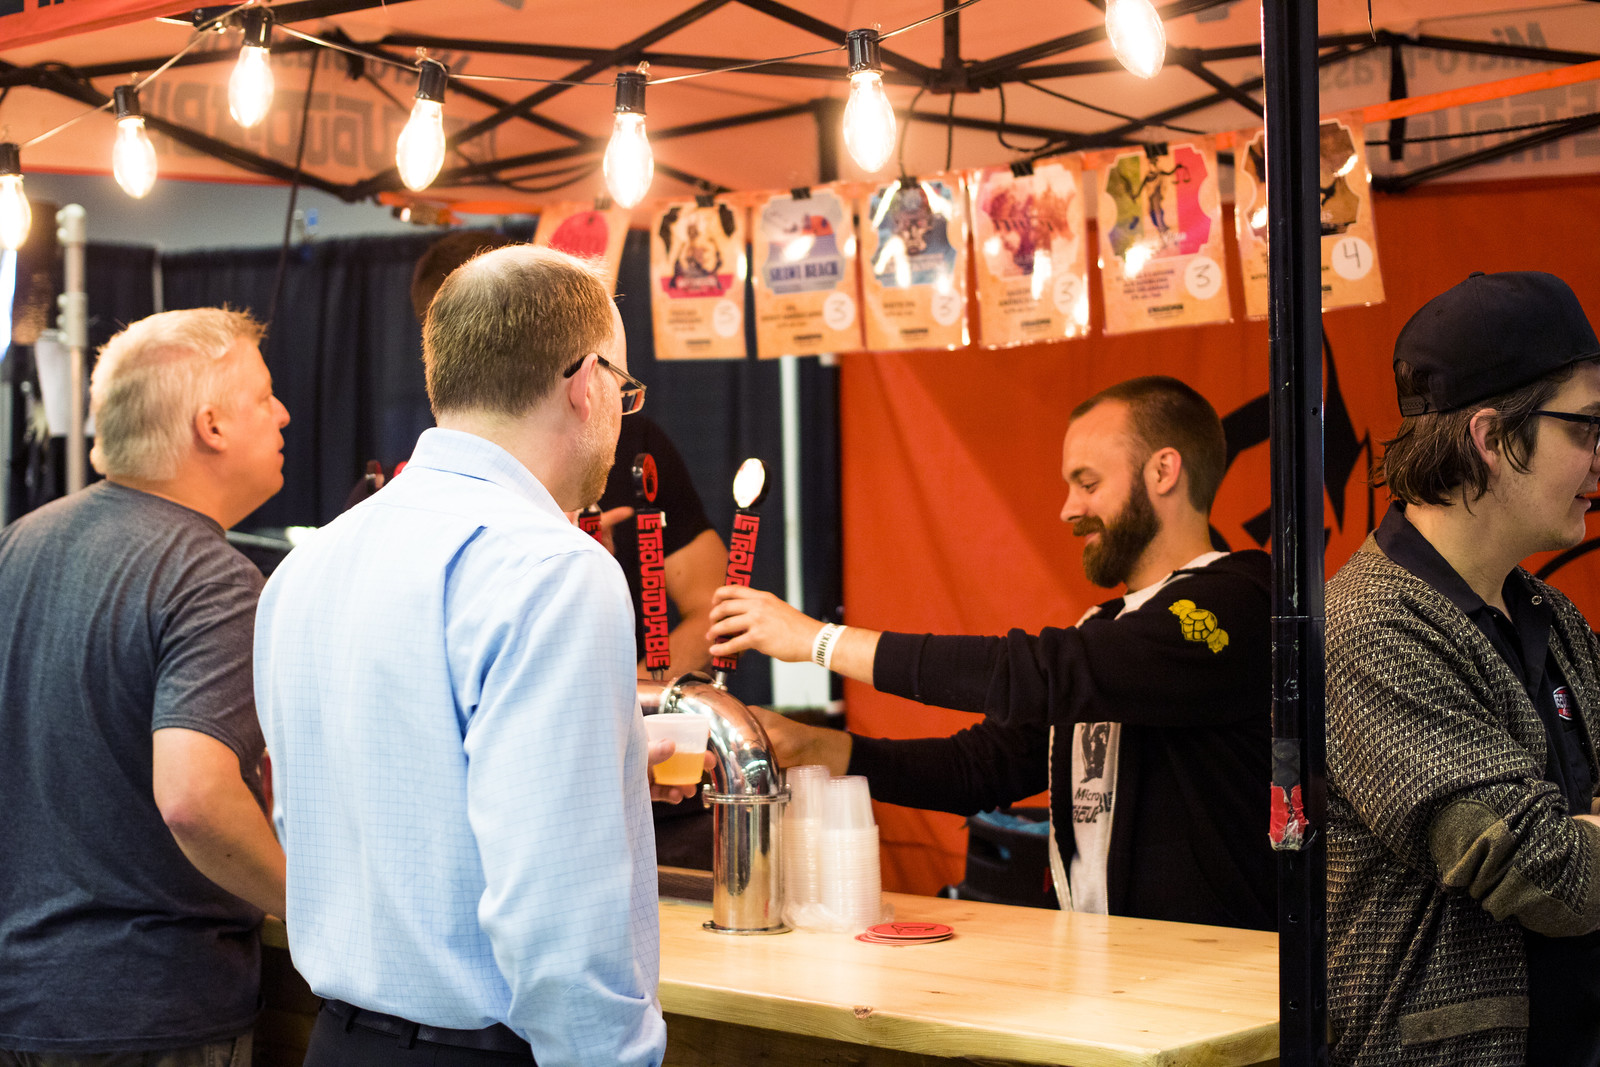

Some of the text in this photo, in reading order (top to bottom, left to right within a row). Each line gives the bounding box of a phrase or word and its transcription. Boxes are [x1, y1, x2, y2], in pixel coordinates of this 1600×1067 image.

[1342, 241, 1361, 269] 4
[1193, 264, 1211, 288] 3
[1060, 280, 1075, 304] 3
[831, 299, 847, 322] 3
[1075, 788, 1101, 801] Micro
